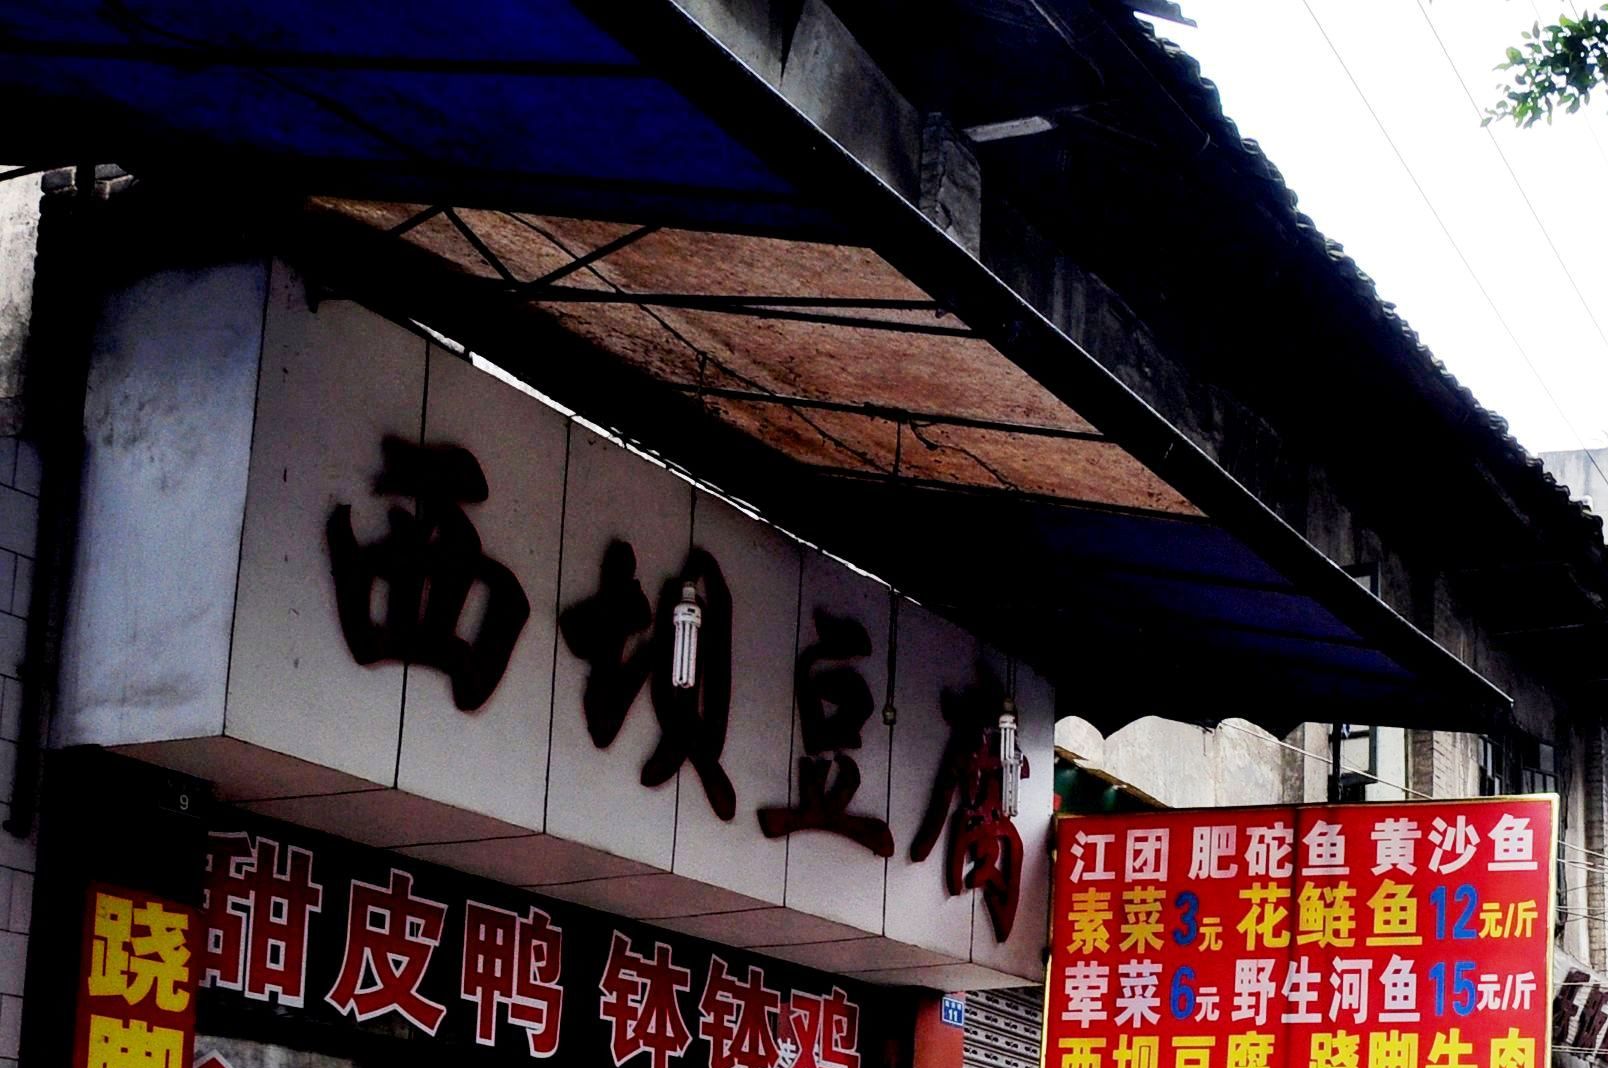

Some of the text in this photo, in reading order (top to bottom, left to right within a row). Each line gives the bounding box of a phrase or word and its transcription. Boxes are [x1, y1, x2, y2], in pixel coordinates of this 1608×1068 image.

[326, 434, 1029, 944] 西坝豆腐
[1069, 813, 1539, 883] 江团 肥砣鱼 黄沙鱼
[201, 832, 564, 1060] 甜皮鸭
[1066, 885, 1223, 955] 素菜3元
[1062, 959, 1220, 1029] 荤菜6元
